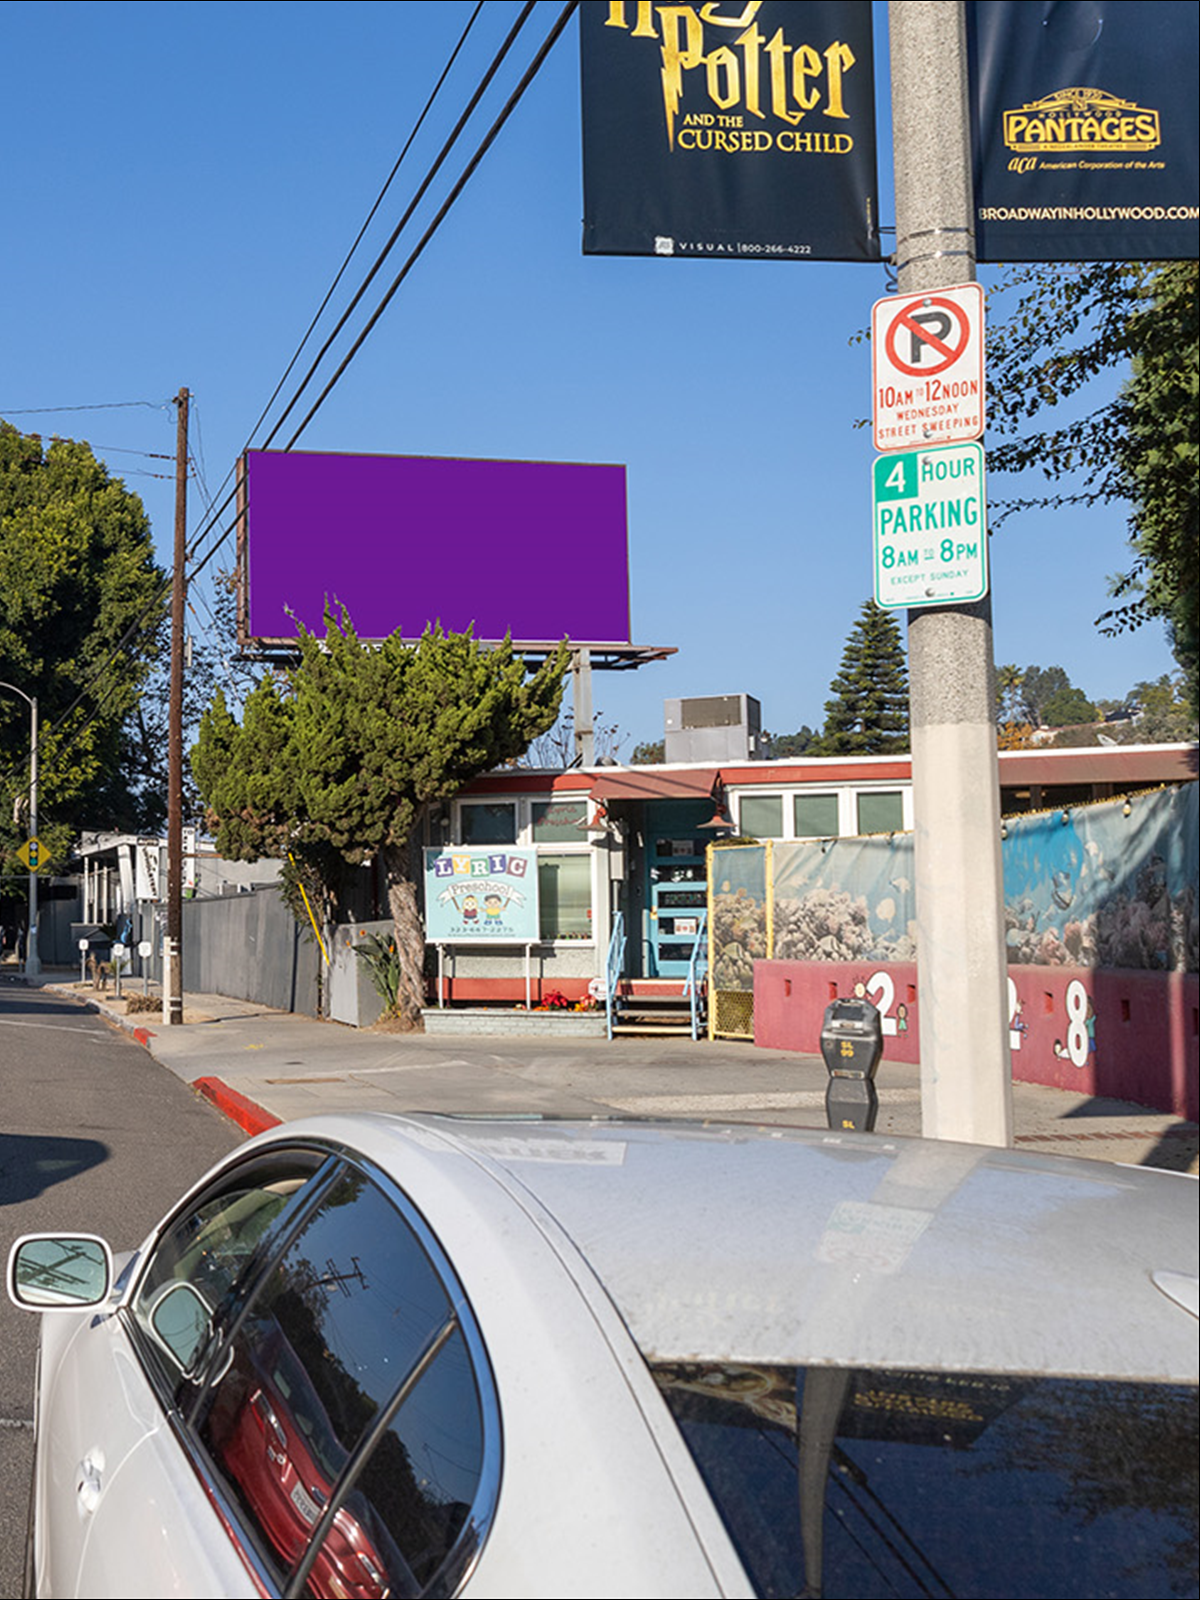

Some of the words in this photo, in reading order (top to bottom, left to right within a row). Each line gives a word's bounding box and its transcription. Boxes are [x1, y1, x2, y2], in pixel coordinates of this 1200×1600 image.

[655, 6, 856, 152] Potter
[683, 114, 715, 126] AND
[717, 115, 744, 127] THE
[1008, 114, 1157, 142] PANTAGES
[677, 129, 773, 153] CURSED
[776, 131, 854, 154] CHILD
[1007, 157, 1038, 174] aca
[1039, 161, 1077, 170] American
[1078, 160, 1122, 171] Corporation
[1124, 160, 1134, 170] of
[1134, 161, 1147, 169] the
[1148, 161, 1166, 169] Arts
[978, 206, 1199, 220] BROADWAYINHOLLYWOOD.COM
[679, 242, 734, 252] VISUAL
[896, 403, 959, 421] WEDNESDAY
[878, 424, 917, 439] STREET
[922, 415, 979, 432] SWEEPING
[885, 461, 906, 493] 4
[922, 457, 975, 482] HOUR
[880, 496, 978, 536] PARKING
[890, 573, 926, 585] EXCEPT
[930, 569, 969, 582] SUNDAY
[435, 854, 527, 877] LYRIC
[451, 880, 511, 896] Preschool
